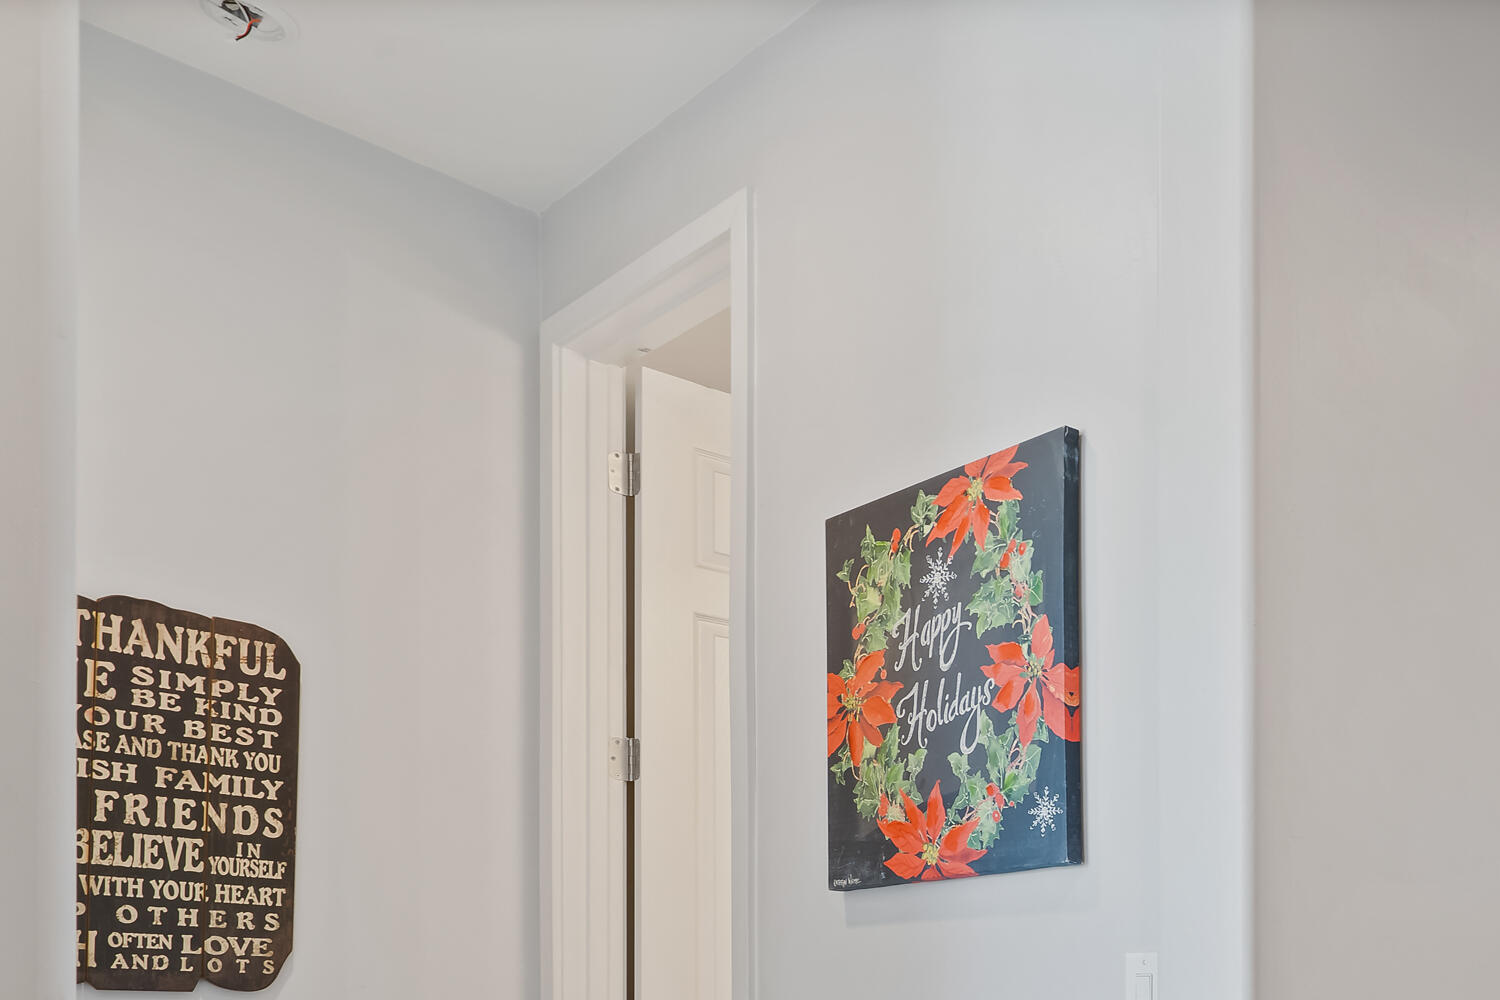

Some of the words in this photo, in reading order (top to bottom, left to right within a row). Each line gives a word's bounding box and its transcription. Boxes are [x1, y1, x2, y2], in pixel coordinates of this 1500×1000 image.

[892, 602, 972, 671] Happy
[130, 665, 283, 706] SIMPLY
[131, 689, 181, 711] BE
[195, 698, 283, 725] KIND
[896, 672, 995, 754] Holidays
[184, 720, 279, 749] BEST
[115, 735, 162, 758] AND
[167, 741, 239, 768] THANK
[243, 752, 281, 774] YOU
[155, 766, 284, 801] FAMILY
[94, 789, 284, 839] FRIENDS
[77, 828, 205, 873] BELIEVE
[208, 856, 287, 880] YOURSELF
[236, 842, 261, 859] IN
[79, 875, 144, 898] WITH
[149, 880, 209, 903] YOUR
[215, 884, 287, 907] HEART
[115, 905, 280, 931] OTHERS
[108, 932, 173, 950] OFTEN
[181, 934, 274, 957] LOVE
[110, 954, 169, 971] AND
[180, 957, 275, 974] LOTS
